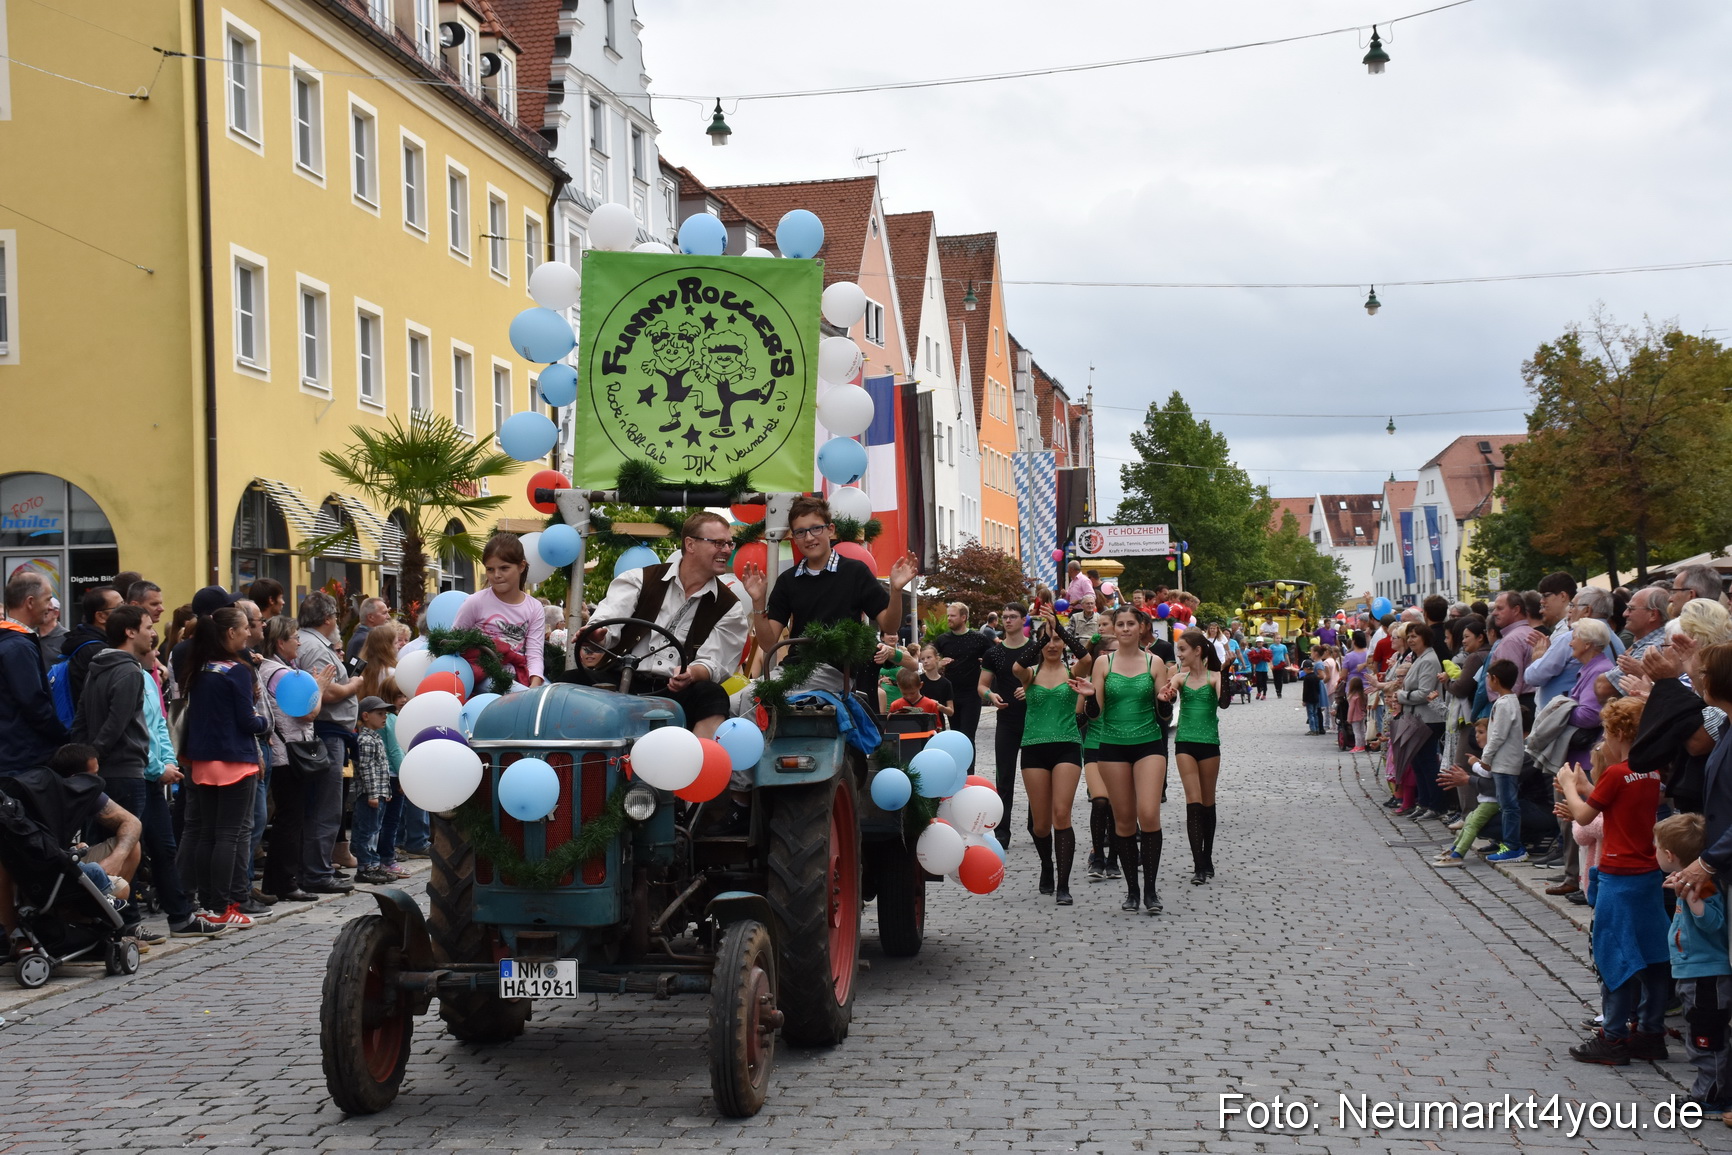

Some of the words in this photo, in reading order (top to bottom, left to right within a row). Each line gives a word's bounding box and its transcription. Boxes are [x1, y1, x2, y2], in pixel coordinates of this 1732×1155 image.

[725, 418, 780, 464] Neumarkt
[682, 455, 716, 477] DJK
[11, 496, 44, 518] FOTO
[1, 515, 59, 529] hailer
[1108, 528, 1118, 536] FC
[1120, 527, 1164, 535] HOLZHEIM
[70, 576, 100, 584] Digitale
[518, 962, 541, 978] NM
